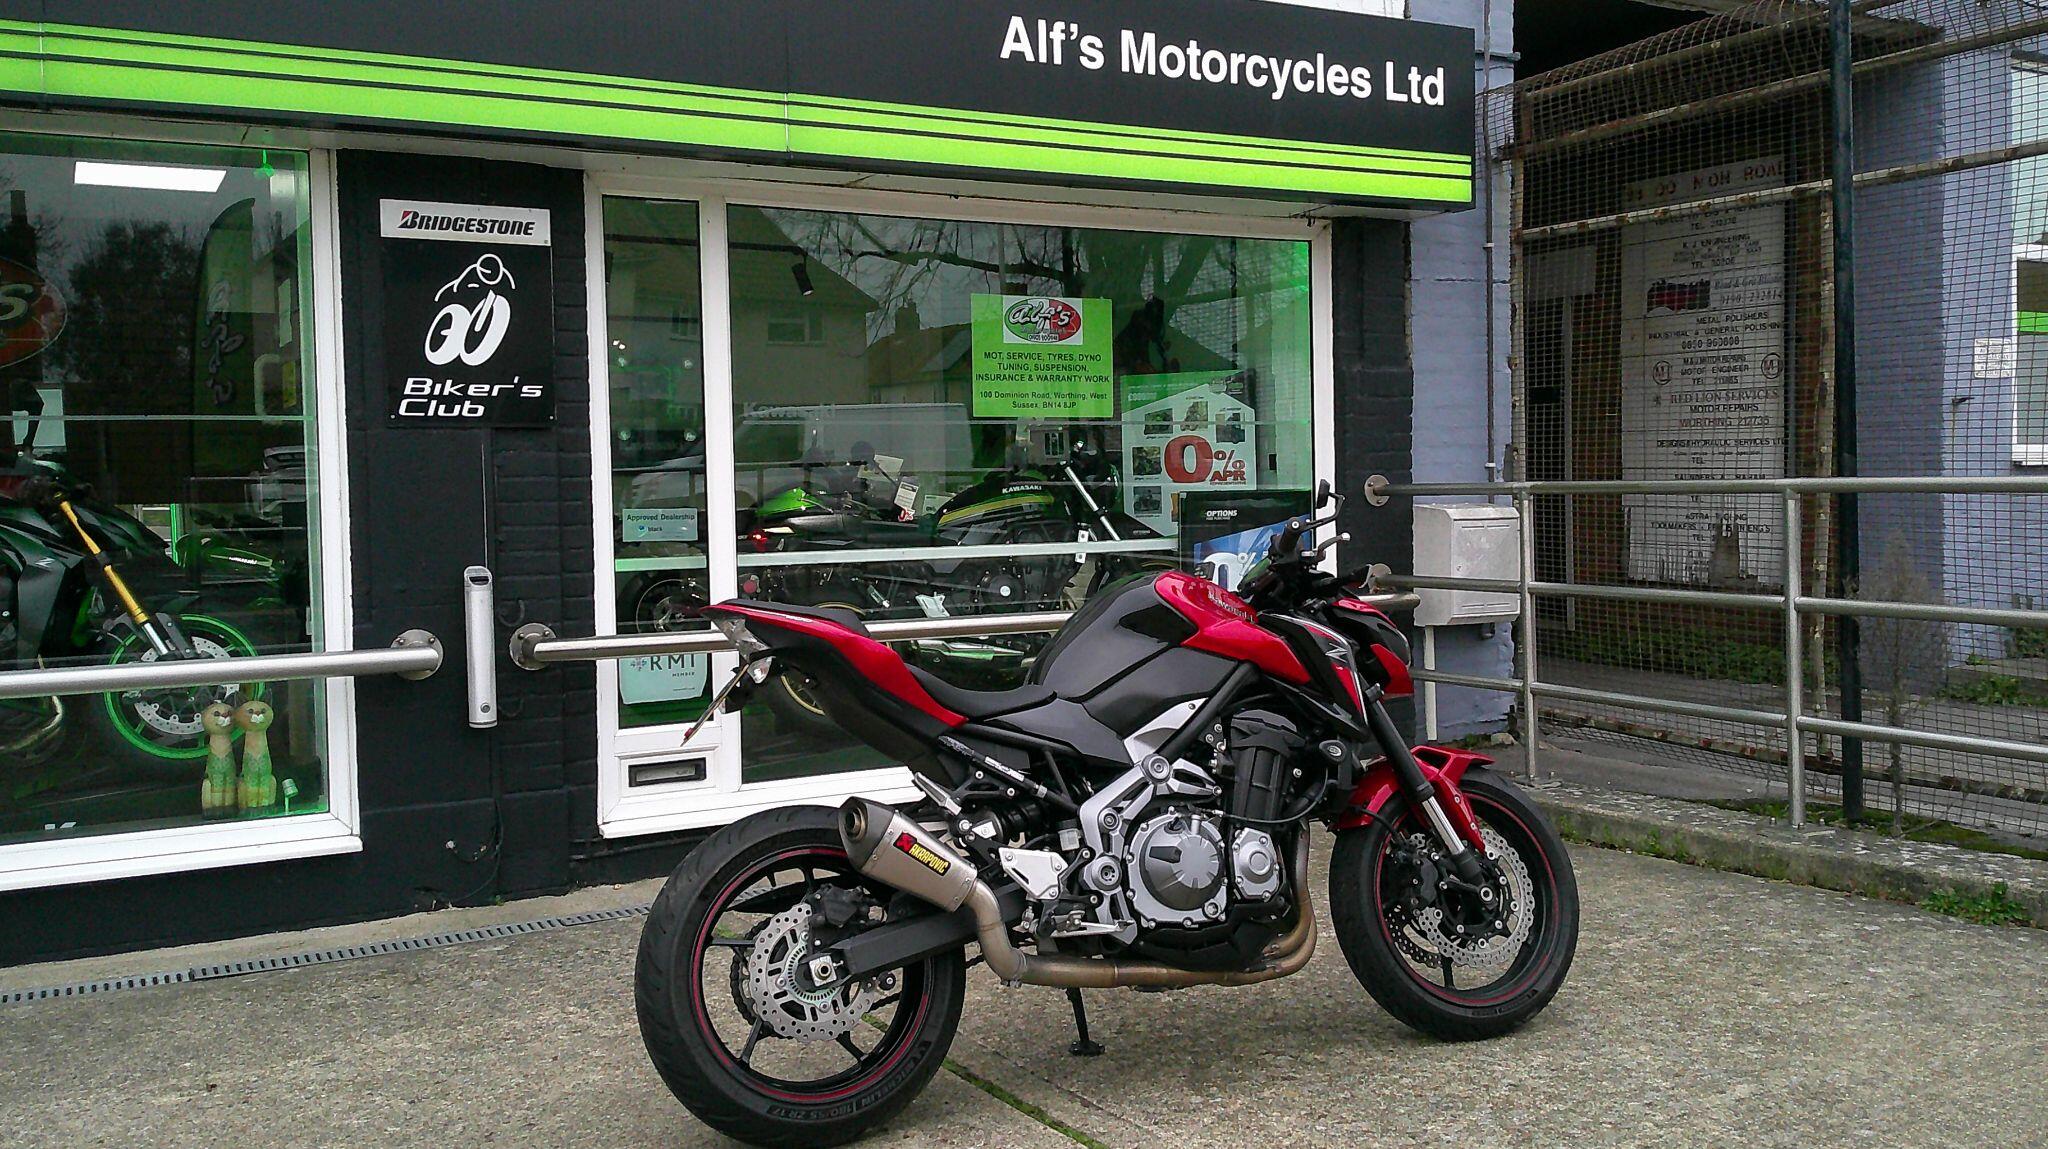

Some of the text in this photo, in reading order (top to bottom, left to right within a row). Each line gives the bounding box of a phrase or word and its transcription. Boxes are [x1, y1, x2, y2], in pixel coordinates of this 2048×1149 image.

[1000, 15, 1445, 106] Alf's Motorcycles Ltd
[398, 210, 536, 236] BRIDGESTONE
[984, 352, 1004, 361] MOT,
[1007, 352, 1045, 362] SERVICE,
[1078, 353, 1102, 362] DYNO
[997, 363, 1089, 373] TUNING, SUSPENSION,
[975, 374, 1110, 383] INSURANCE & WARRANTY WORK
[403, 376, 544, 398] Biker's
[980, 391, 993, 399] 100
[995, 391, 1030, 399] Dominion
[1089, 392, 1108, 400] West
[399, 398, 485, 417] Club
[1209, 470, 1247, 482] APR
[1001, 484, 1043, 494] KAWASAKI
[626, 513, 696, 522] Approved Dealership
